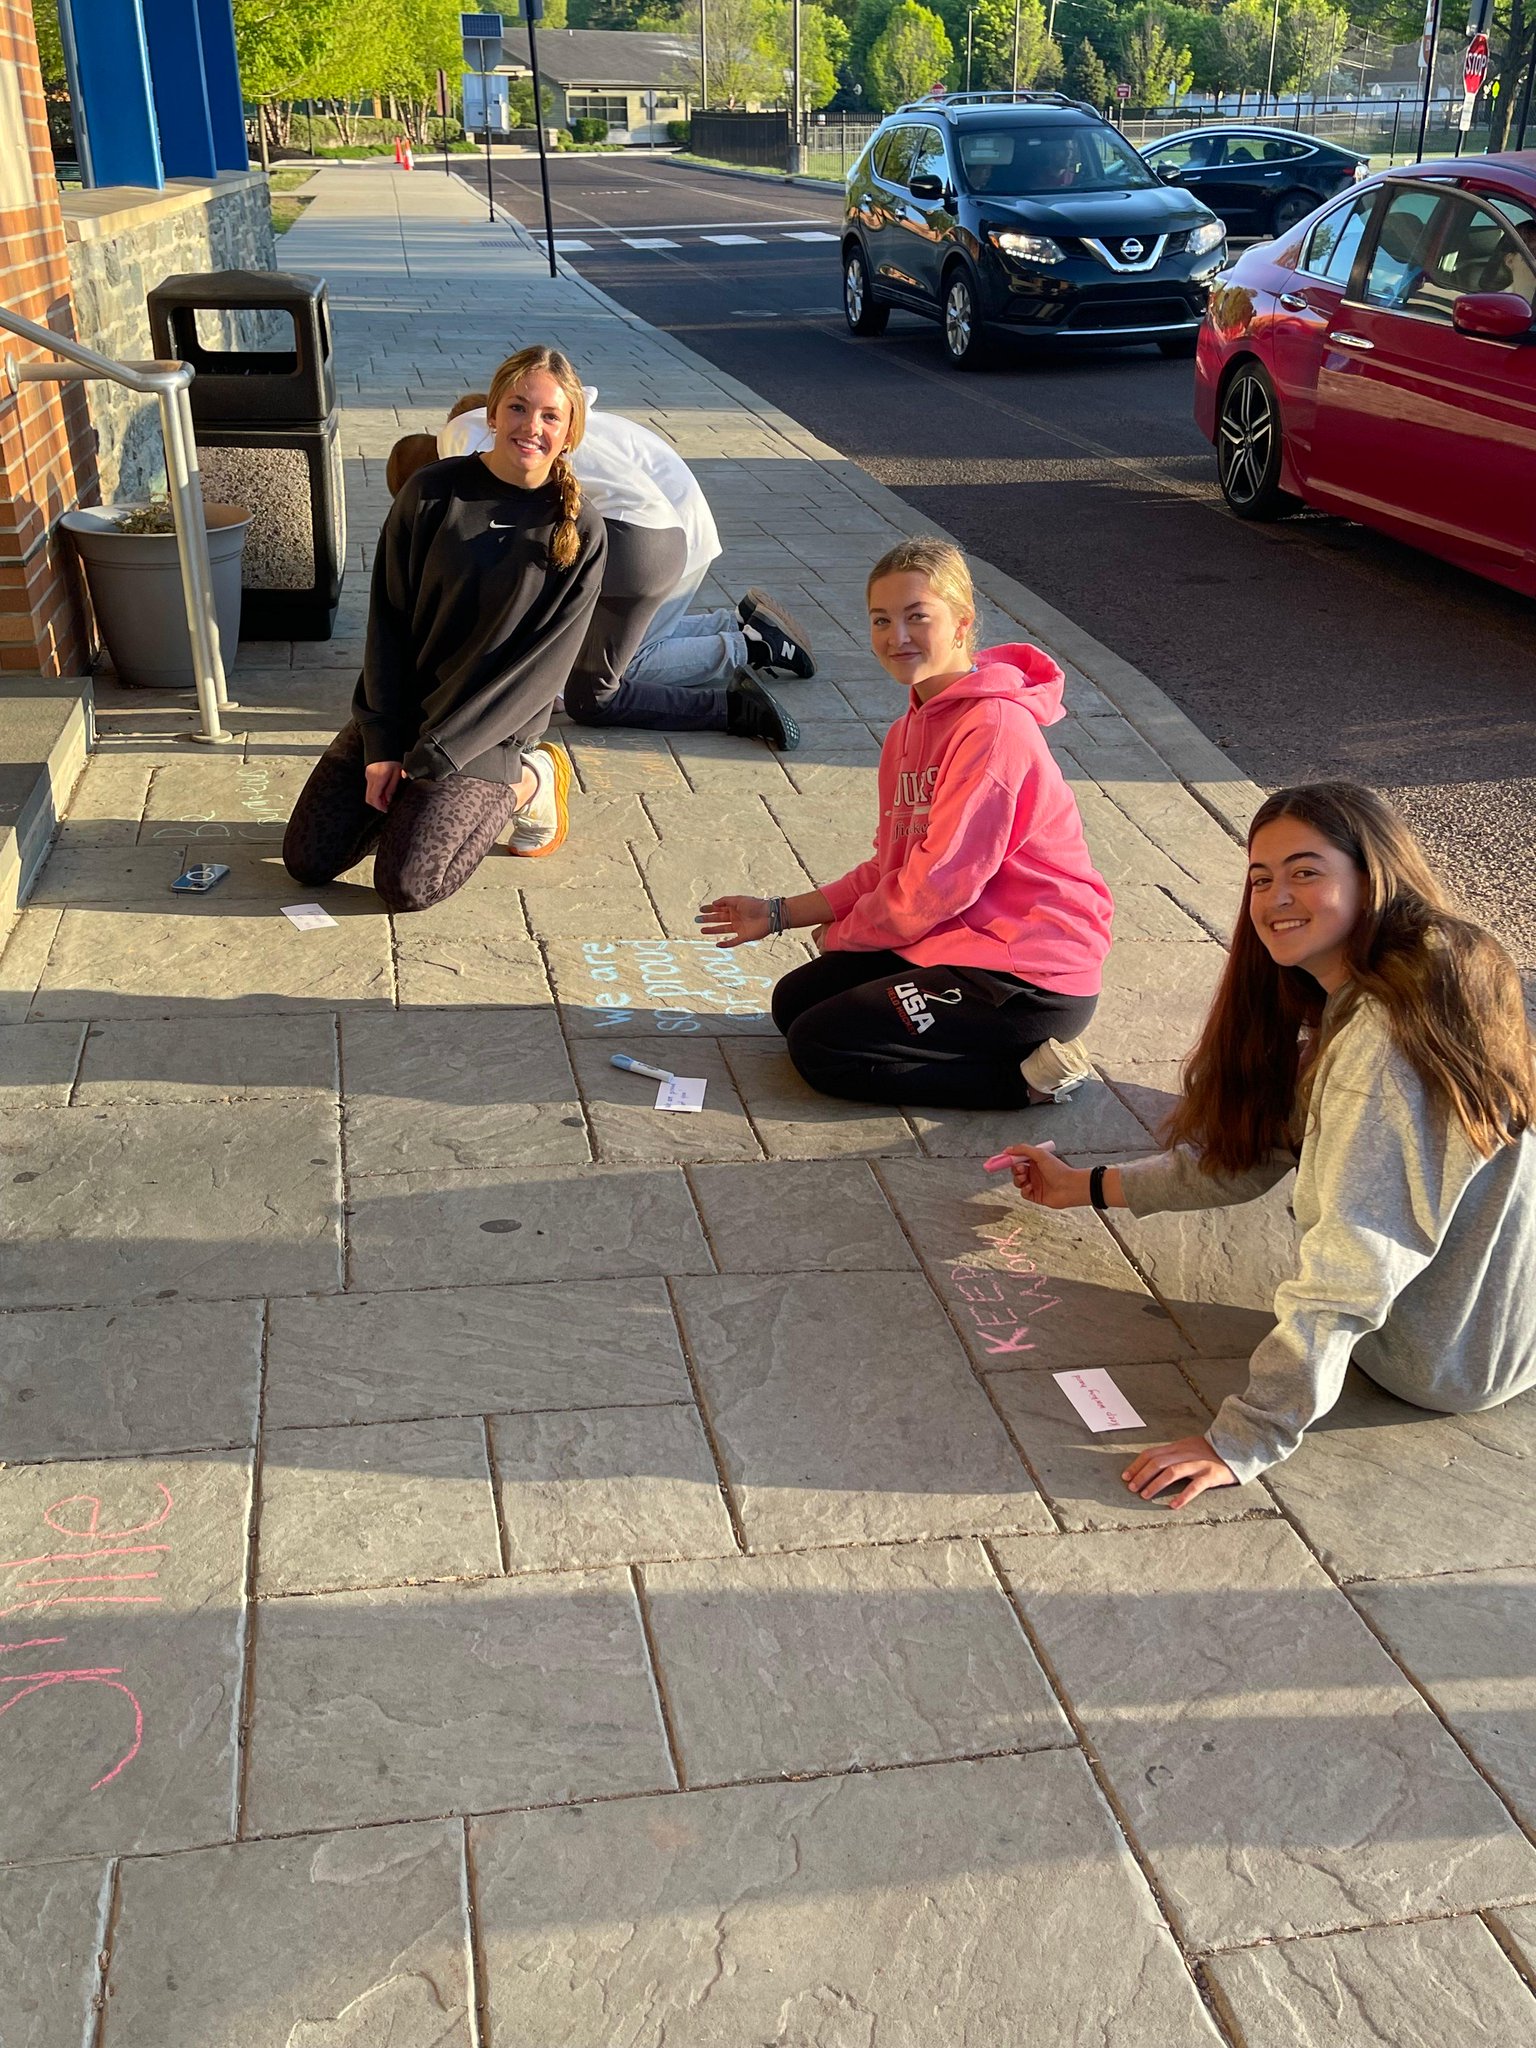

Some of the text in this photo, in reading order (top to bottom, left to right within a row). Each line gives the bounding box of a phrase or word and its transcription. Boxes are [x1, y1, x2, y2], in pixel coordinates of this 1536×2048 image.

[1465, 53, 1487, 76] STOP
[781, 641, 796, 660] N
[582, 942, 620, 982] are
[618, 940, 706, 996] proud
[702, 990, 765, 1021] of
[894, 982, 935, 1034] USA
[951, 1265, 1038, 1354] KEEP
